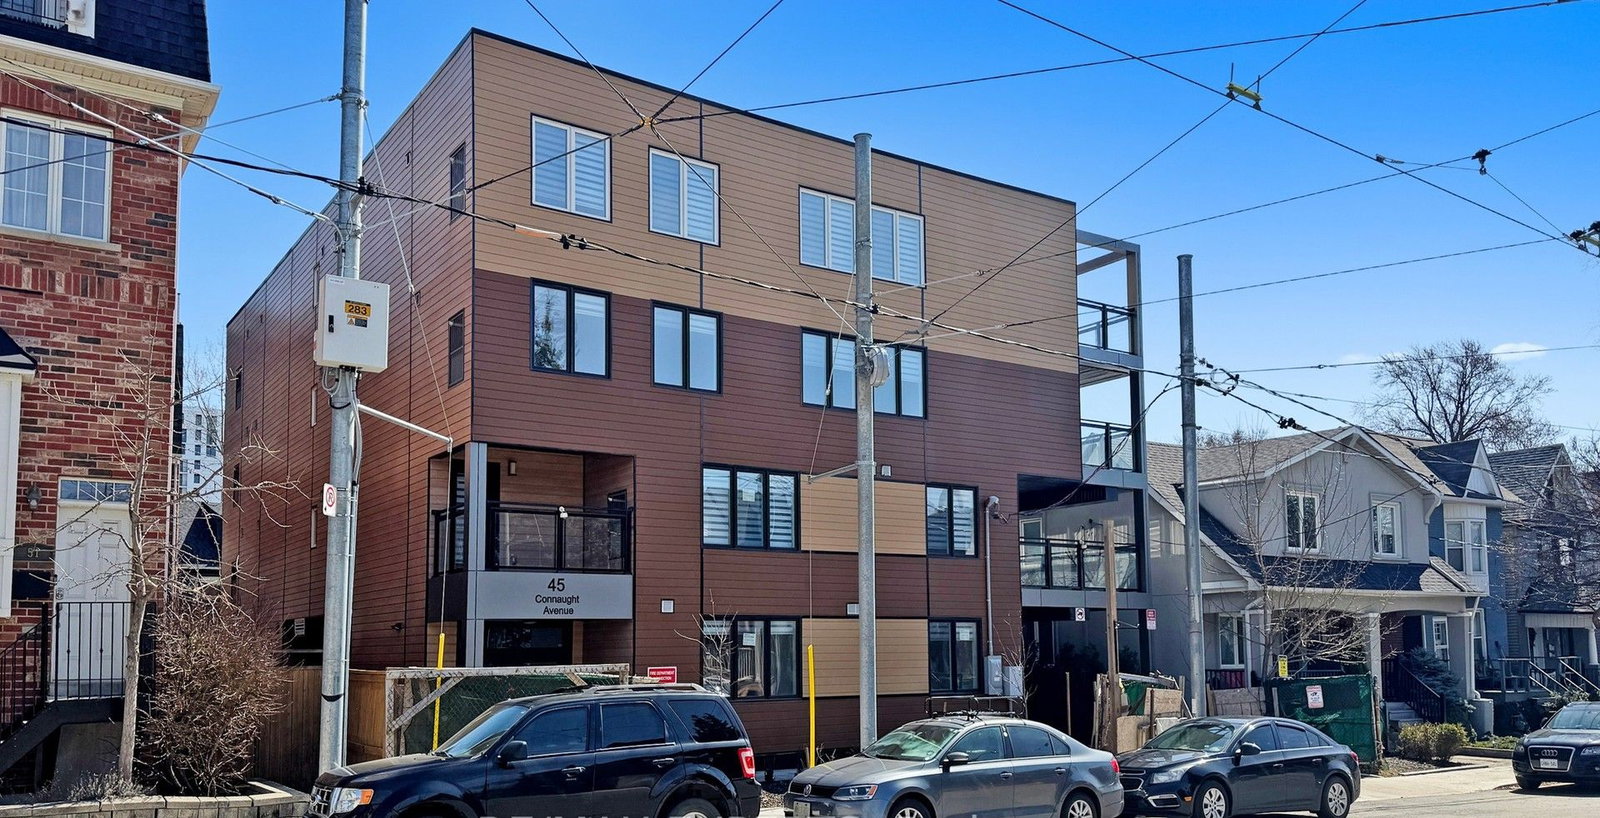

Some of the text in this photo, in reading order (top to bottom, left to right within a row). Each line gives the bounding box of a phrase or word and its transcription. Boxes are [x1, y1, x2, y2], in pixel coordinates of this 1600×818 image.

[348, 304, 367, 315] 283
[547, 578, 565, 592] 45
[535, 594, 580, 605] Connaught
[543, 606, 574, 615] Avenue
